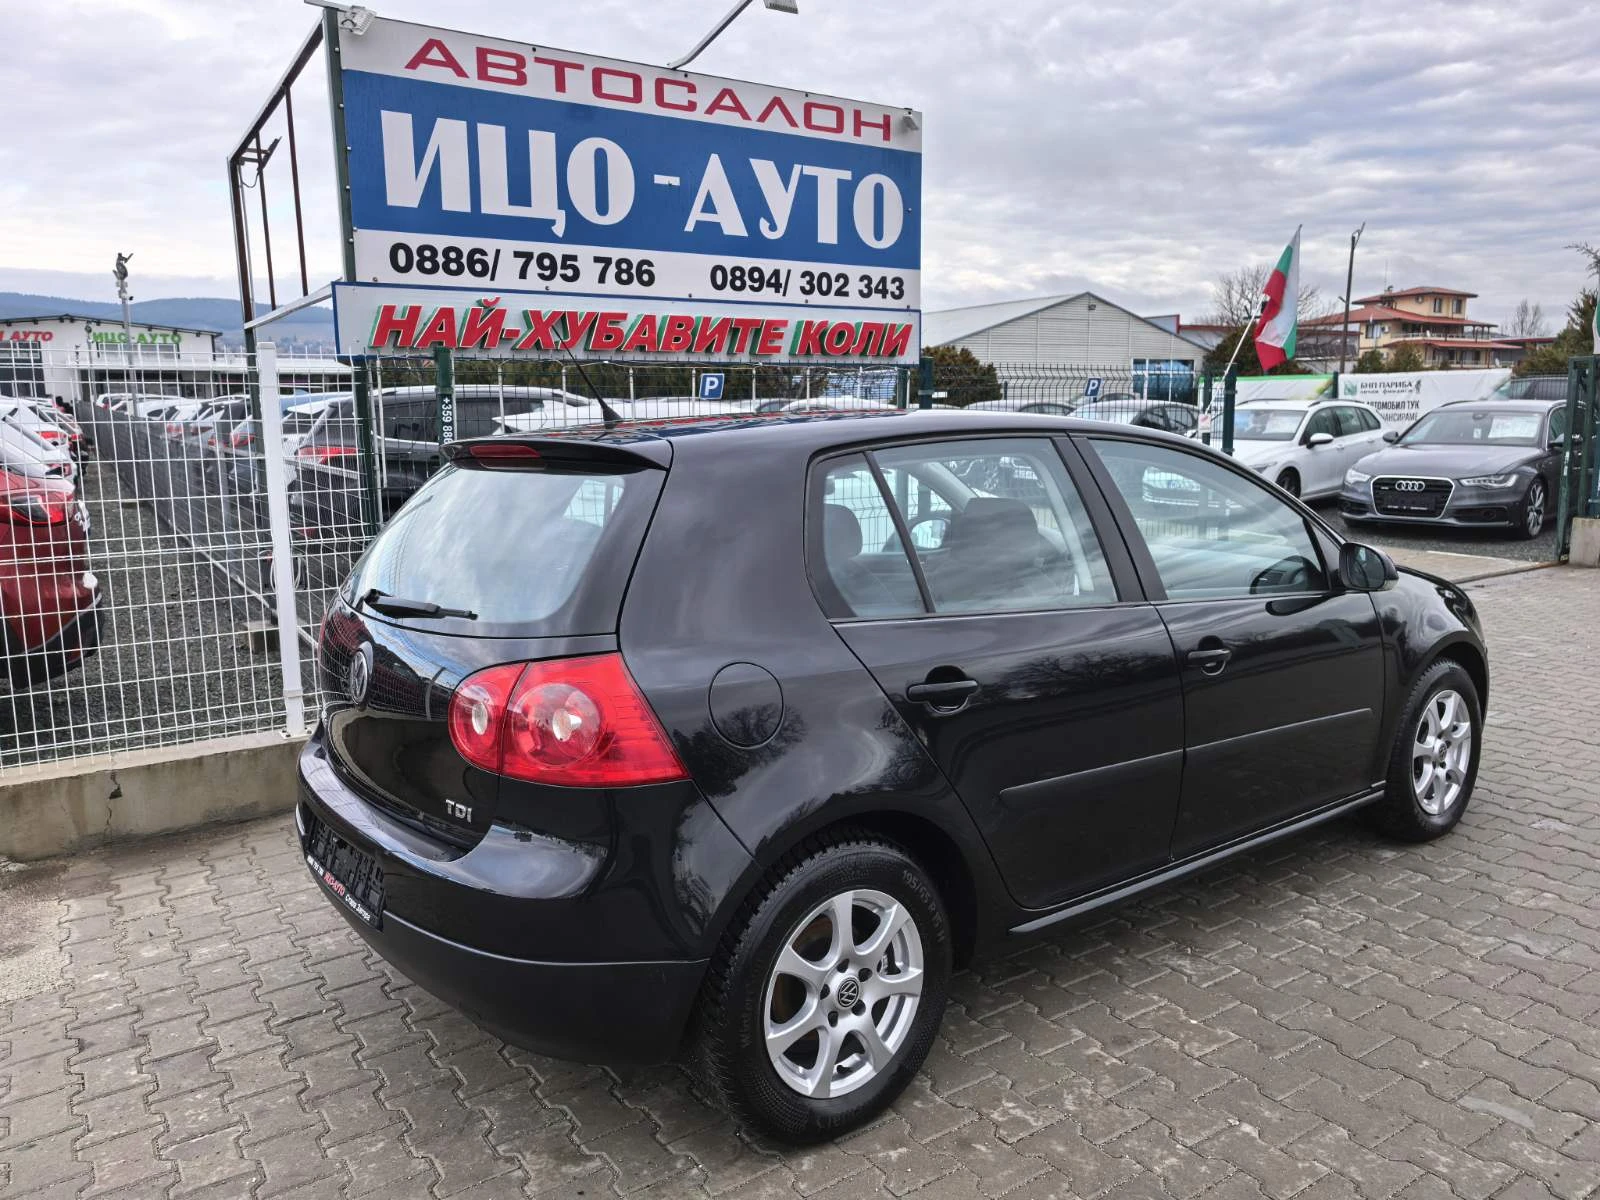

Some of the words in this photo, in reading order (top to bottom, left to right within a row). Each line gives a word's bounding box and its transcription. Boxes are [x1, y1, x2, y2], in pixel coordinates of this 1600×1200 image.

[404, 38, 891, 142] АВТОСАЛОН
[389, 242, 501, 282] 0886/
[513, 250, 581, 284] 795
[593, 255, 656, 287] 786
[710, 264, 791, 297] 0894/
[800, 270, 849, 298] 302
[858, 275, 905, 300] 343
[368, 296, 788, 356] НАЙ-ХУБАВИТЕ
[789, 319, 912, 357] КОЛИ
[705, 376, 719, 396] P
[1379, 380, 1413, 389] ПАРИБА
[441, 396, 453, 423] +359
[1407, 400, 1420, 409] ТУК
[446, 799, 473, 823] TDI
